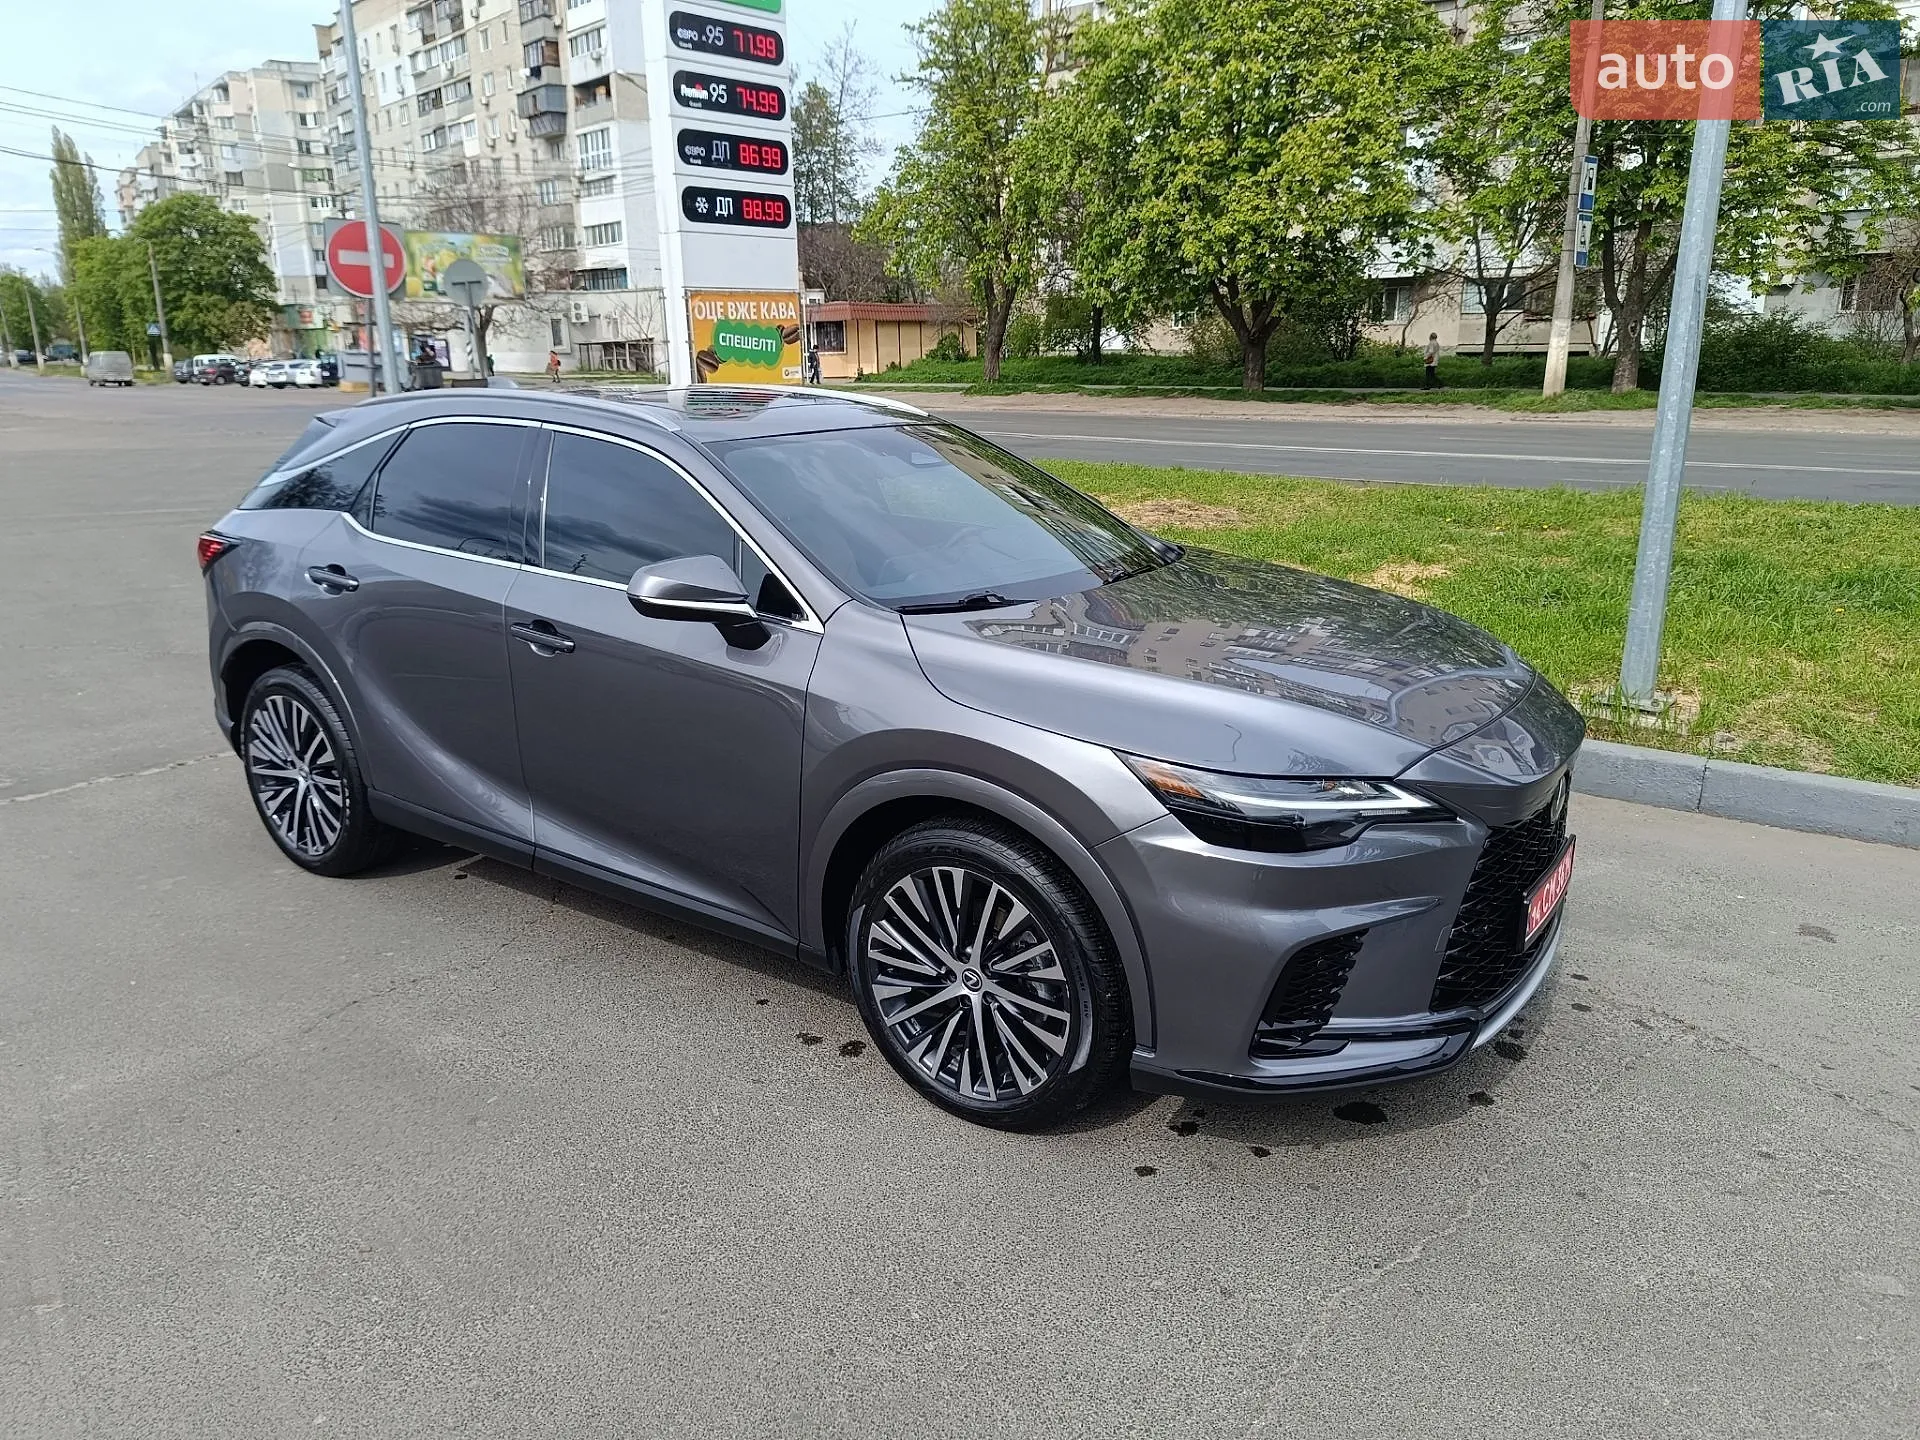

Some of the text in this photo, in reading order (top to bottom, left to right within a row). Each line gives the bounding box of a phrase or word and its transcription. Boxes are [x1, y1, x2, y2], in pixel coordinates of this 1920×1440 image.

[733, 30, 776, 58] 71.99
[710, 83, 727, 104] 95
[736, 87, 778, 114] 74.99
[712, 140, 730, 162] ДП
[716, 197, 784, 222] ДП 88.99
[694, 300, 797, 322] ОЦЕ ВЖЕ КАВА
[719, 332, 776, 353] СПЕШЕЛТІ
